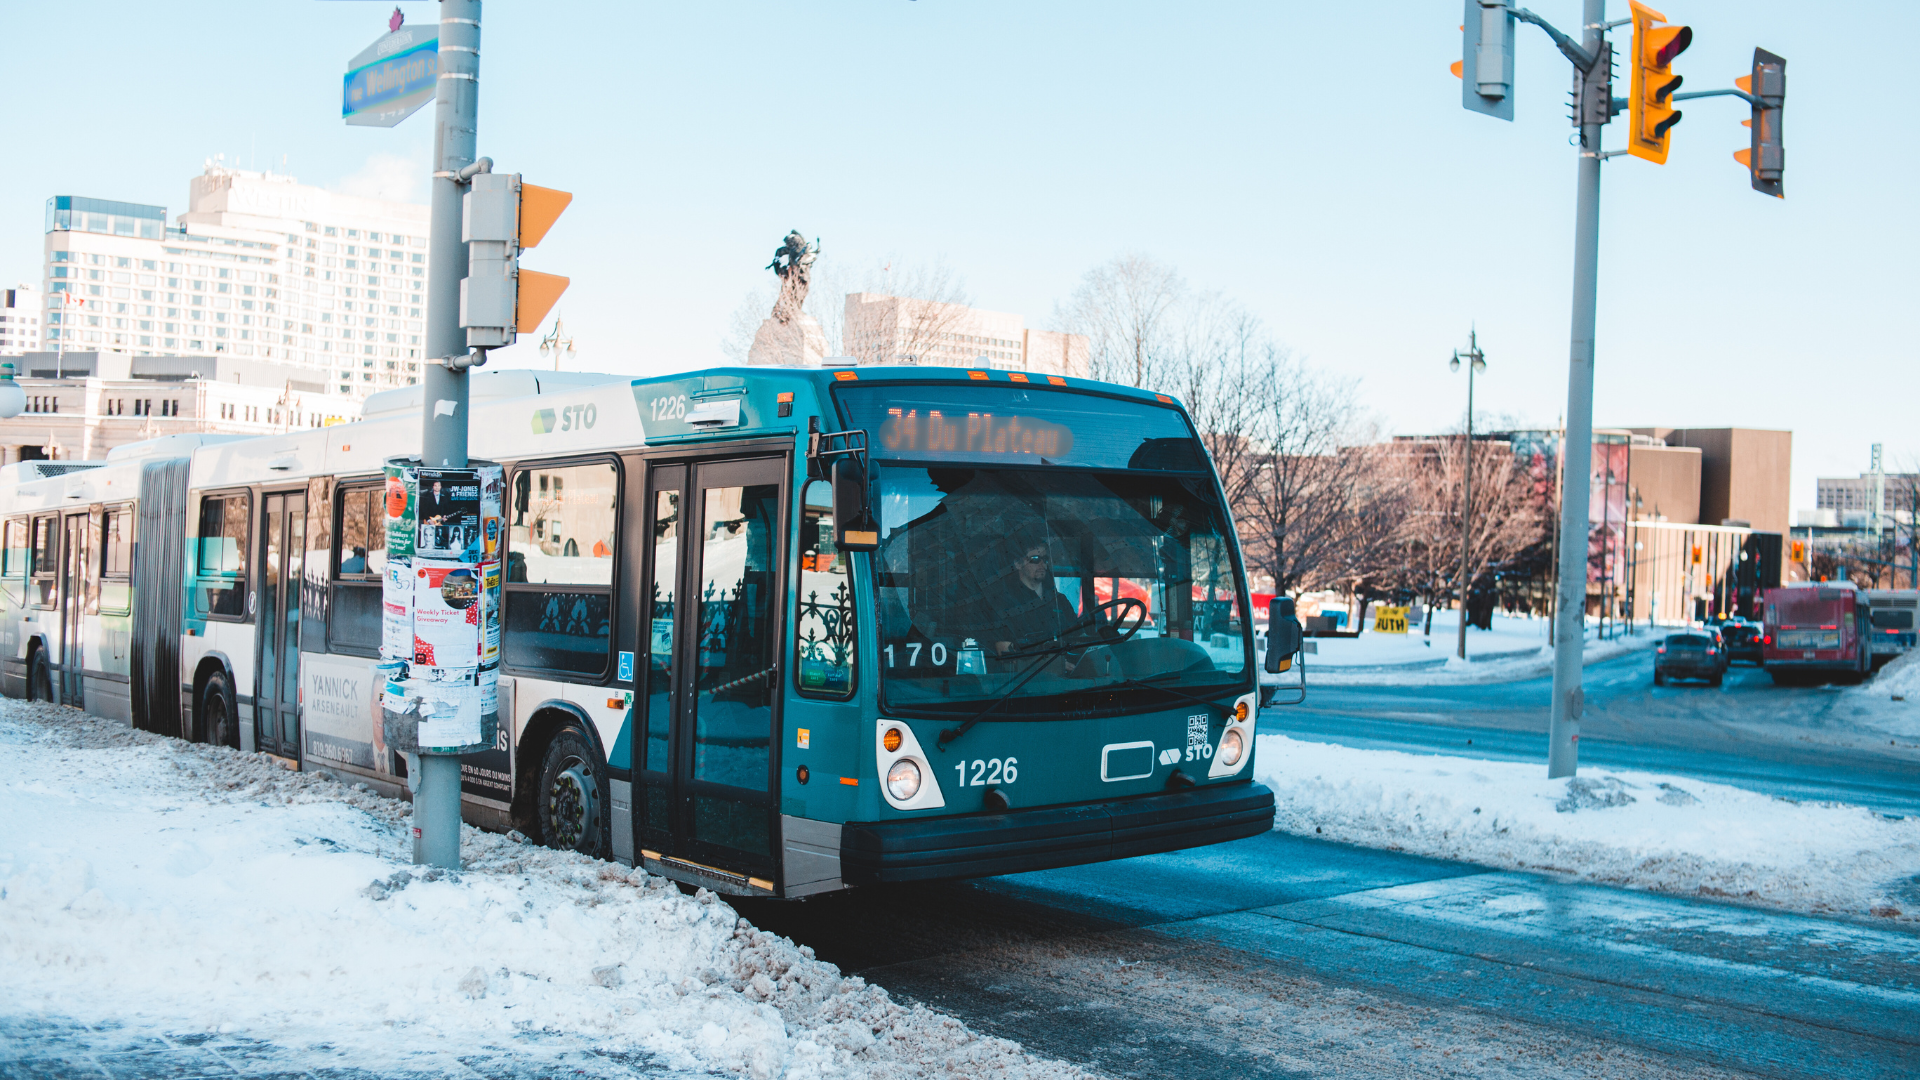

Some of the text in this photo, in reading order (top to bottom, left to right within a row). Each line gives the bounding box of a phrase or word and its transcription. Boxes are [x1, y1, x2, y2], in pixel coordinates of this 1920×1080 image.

[351, 87, 363, 102] rue
[366, 59, 425, 95] Wellington
[561, 402, 597, 431] STO
[650, 394, 686, 422] 1226
[887, 408, 1058, 455] 34 Du Plateau
[468, 555, 478, 563] 19
[417, 608, 440, 617] Weekly
[417, 616, 448, 624] Giveaway
[883, 642, 948, 668] 170
[312, 674, 358, 701] YANNICK
[312, 699, 359, 719] ARSENEAULT
[1185, 743, 1213, 762] STO
[954, 756, 1018, 788] 1226
